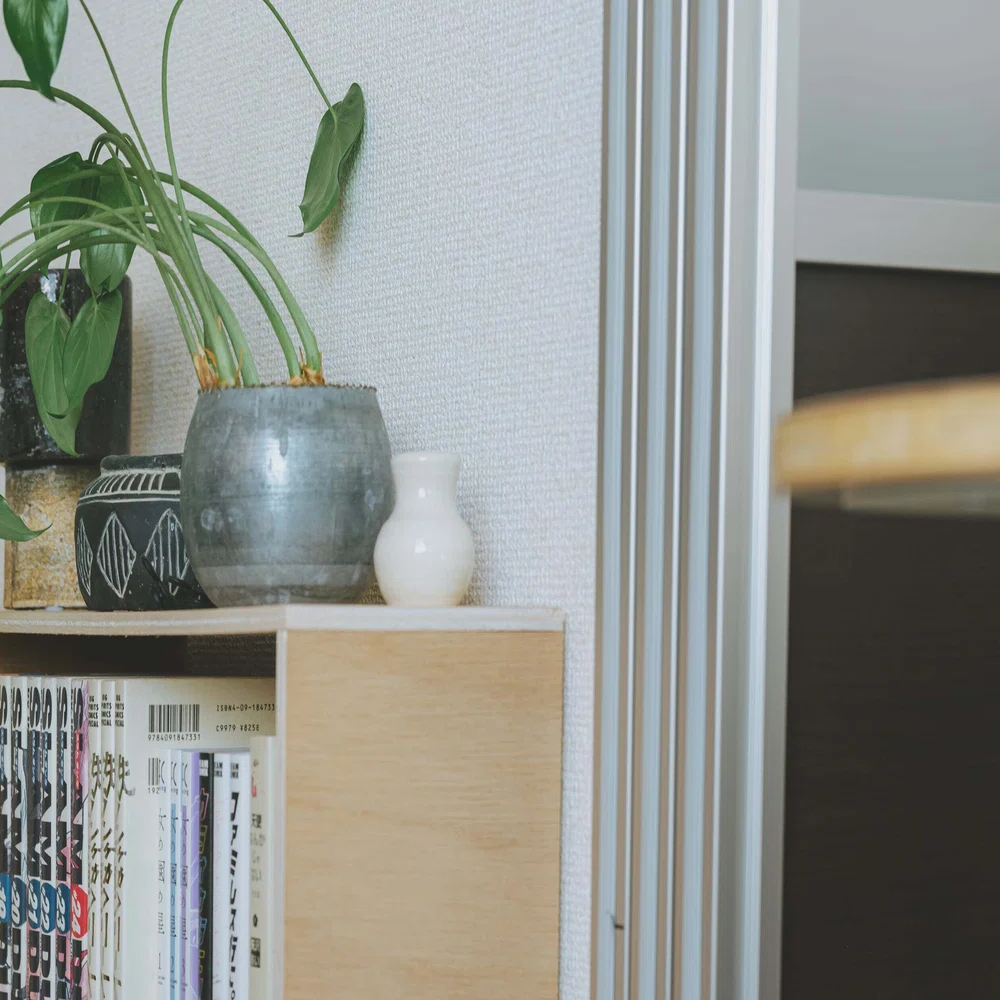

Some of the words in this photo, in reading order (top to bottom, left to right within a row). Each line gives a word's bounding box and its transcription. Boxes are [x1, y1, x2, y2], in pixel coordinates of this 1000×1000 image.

[12, 686, 22, 876] SLAM
[29, 687, 41, 877] SLAM
[41, 687, 52, 881] SLAM
[57, 686, 67, 883] SLAM
[72, 687, 83, 885] SLAM
[148, 733, 200, 742] 9784091847331
